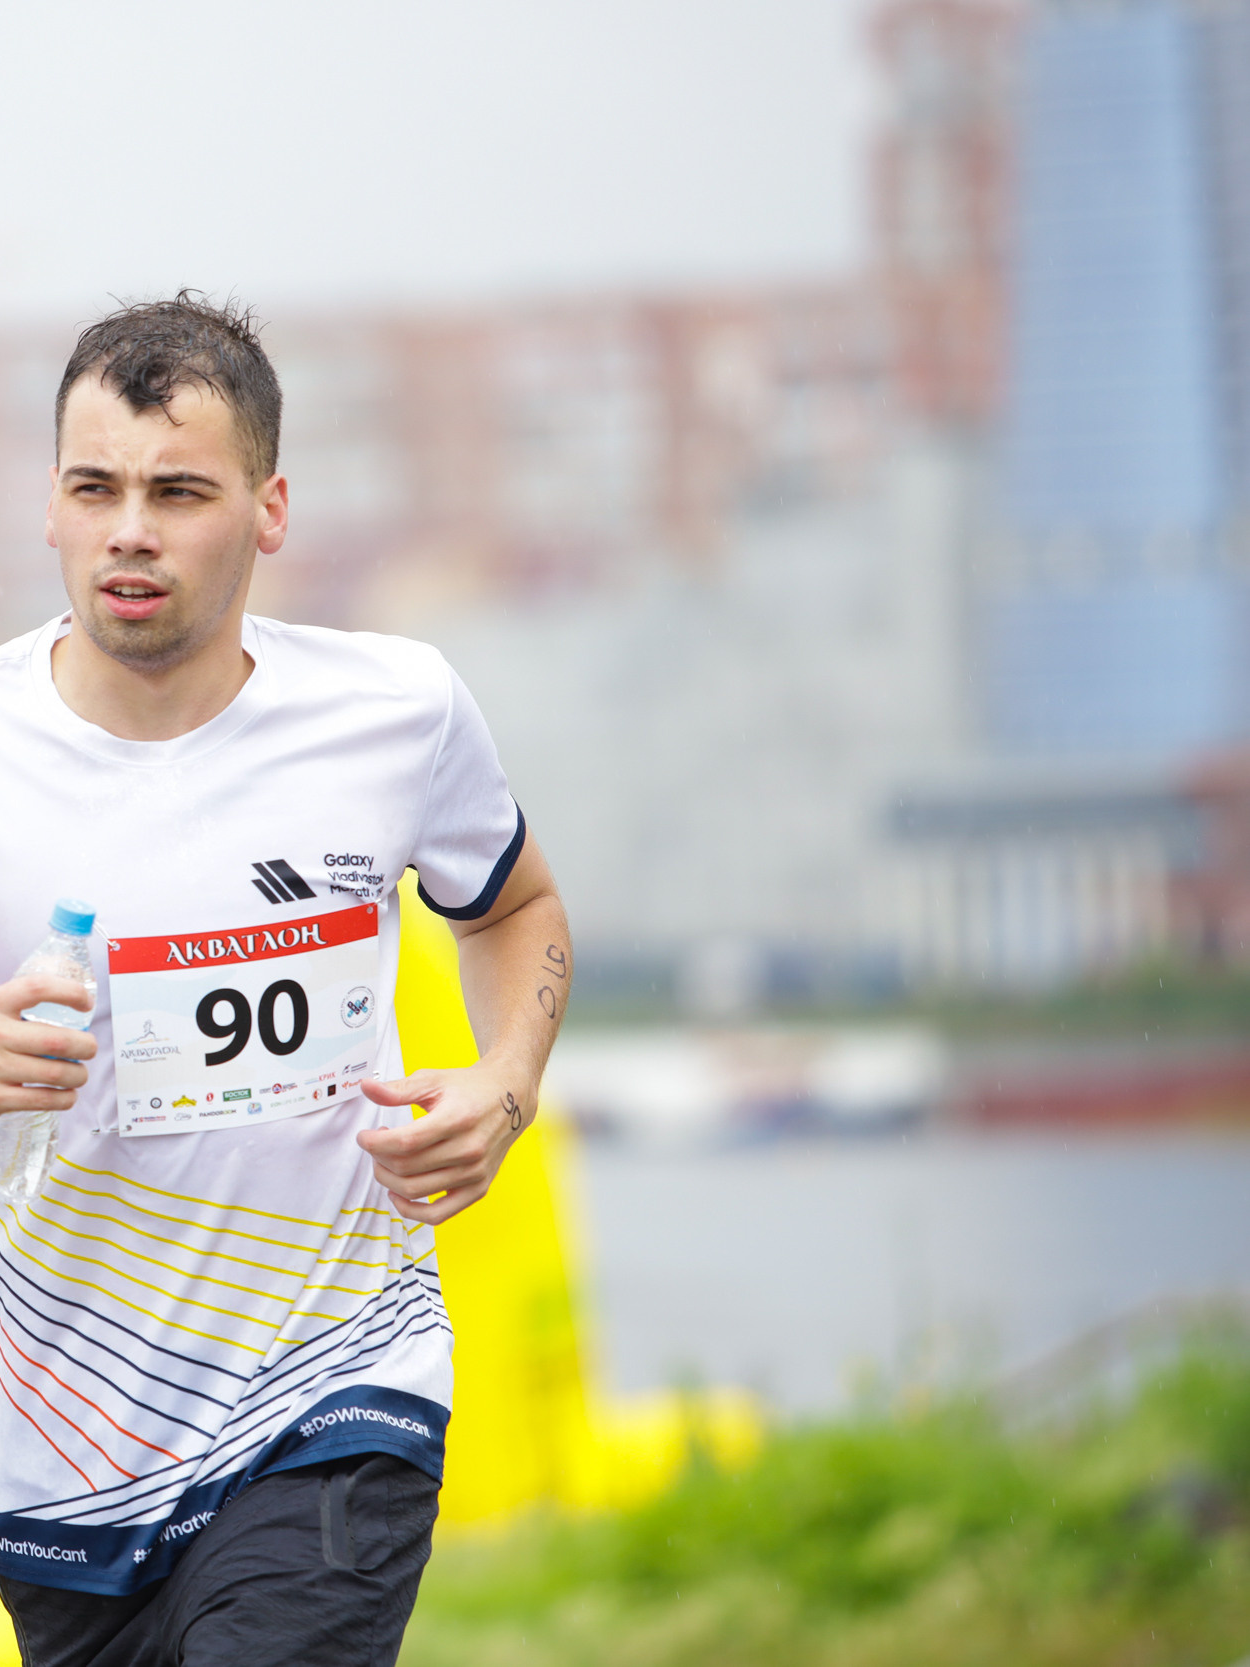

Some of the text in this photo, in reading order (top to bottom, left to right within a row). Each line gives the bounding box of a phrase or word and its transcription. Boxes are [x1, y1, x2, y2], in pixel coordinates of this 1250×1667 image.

[324, 852, 374, 872] Galaxy
[166, 923, 327, 966] АКВАТЛОН
[195, 978, 310, 1067] 90
[299, 1406, 431, 1439] #DoWhatYouCant
